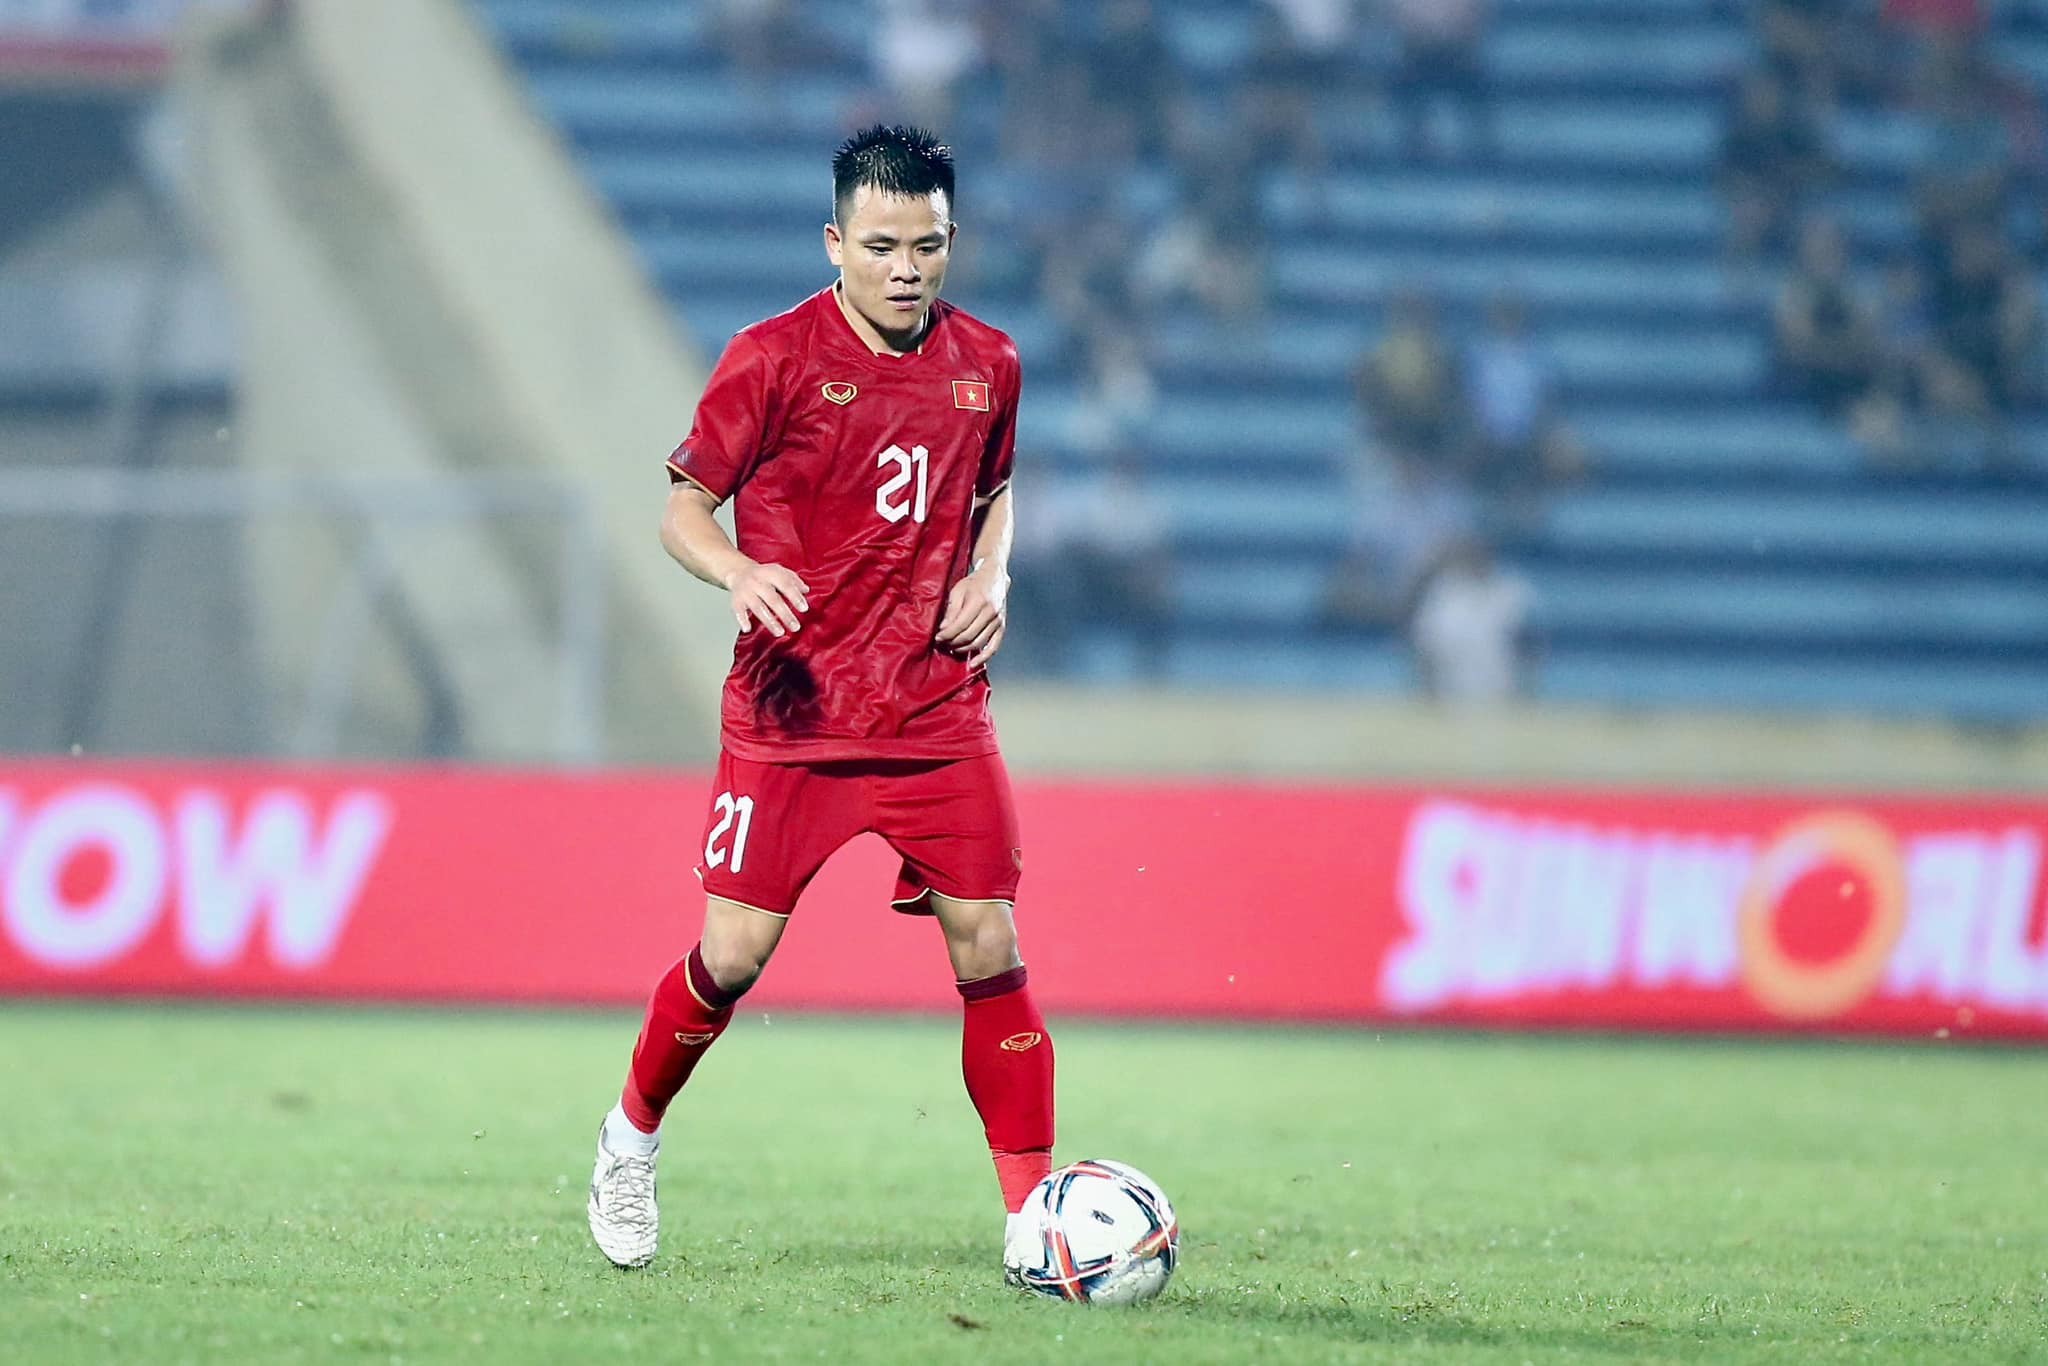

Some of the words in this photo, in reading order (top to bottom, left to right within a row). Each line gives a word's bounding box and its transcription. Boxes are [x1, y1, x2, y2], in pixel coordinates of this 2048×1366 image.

[876, 444, 929, 524] 21
[704, 791, 754, 874] 21
[0, 784, 392, 970] OW
